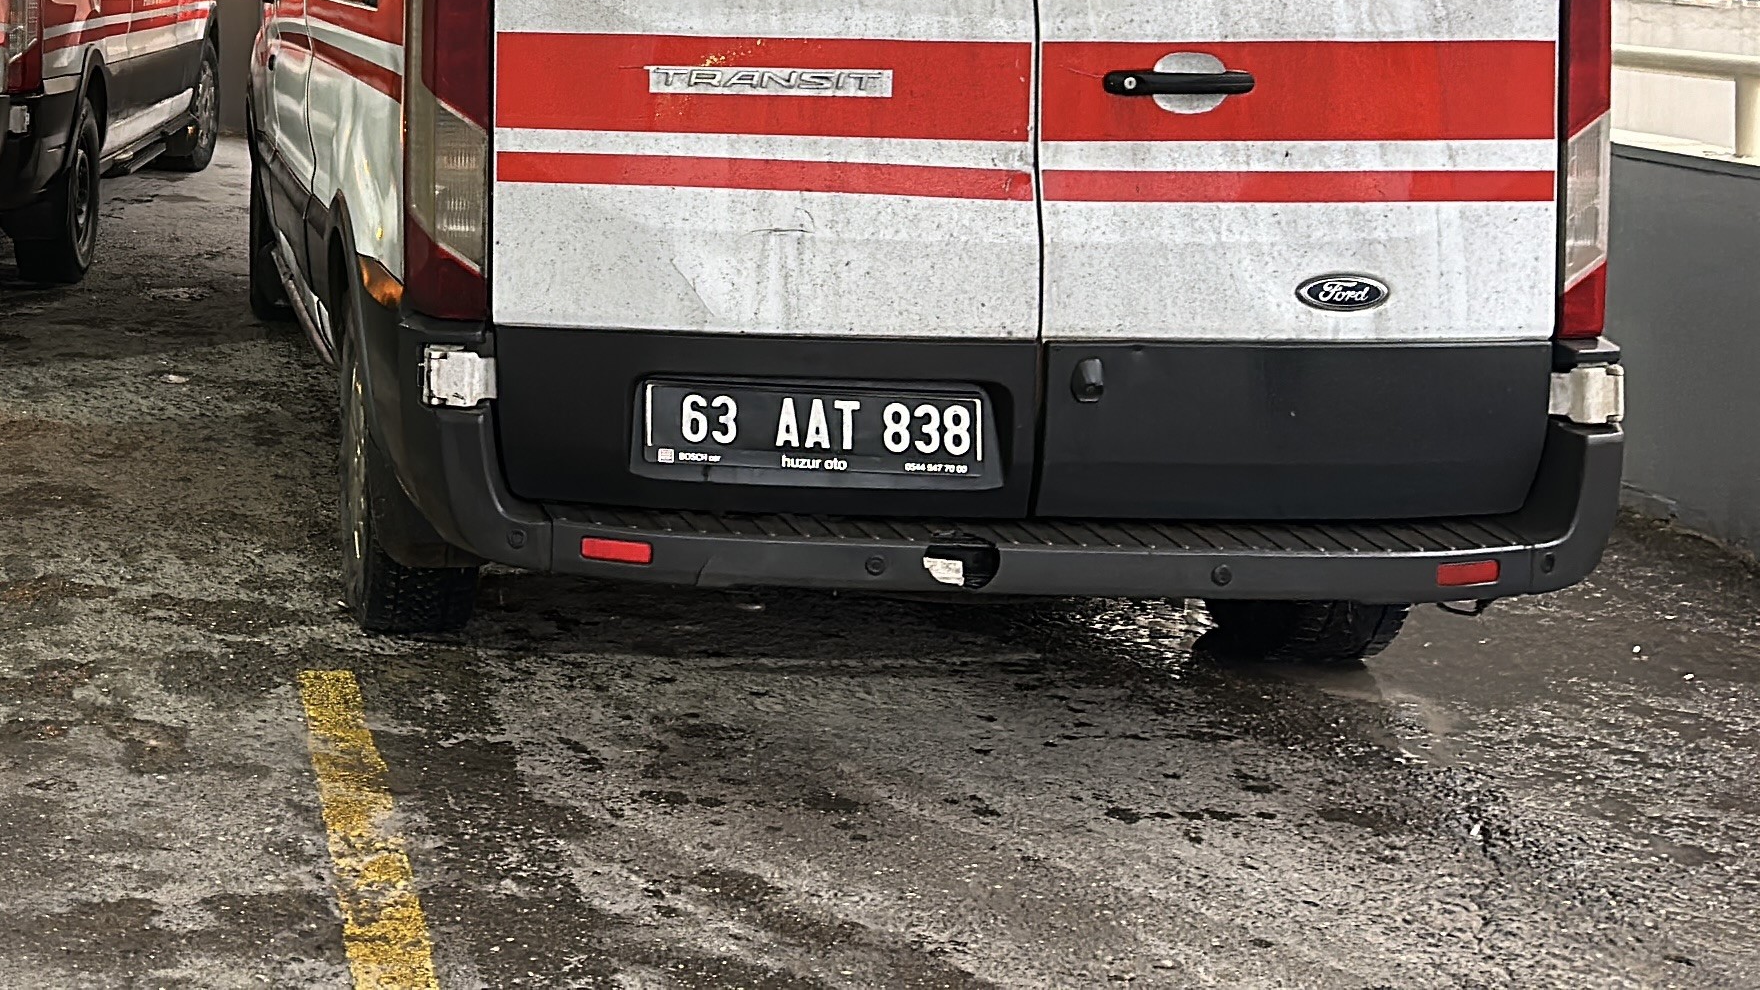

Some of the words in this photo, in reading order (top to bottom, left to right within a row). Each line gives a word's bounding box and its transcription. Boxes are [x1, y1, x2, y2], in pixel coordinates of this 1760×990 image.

[653, 67, 883, 92] TRANSIT
[1318, 281, 1371, 301] Ford
[681, 393, 738, 445] 63
[775, 397, 861, 450] AAT
[882, 402, 971, 456] 838
[781, 454, 823, 469] huzur
[824, 457, 848, 471] oto
